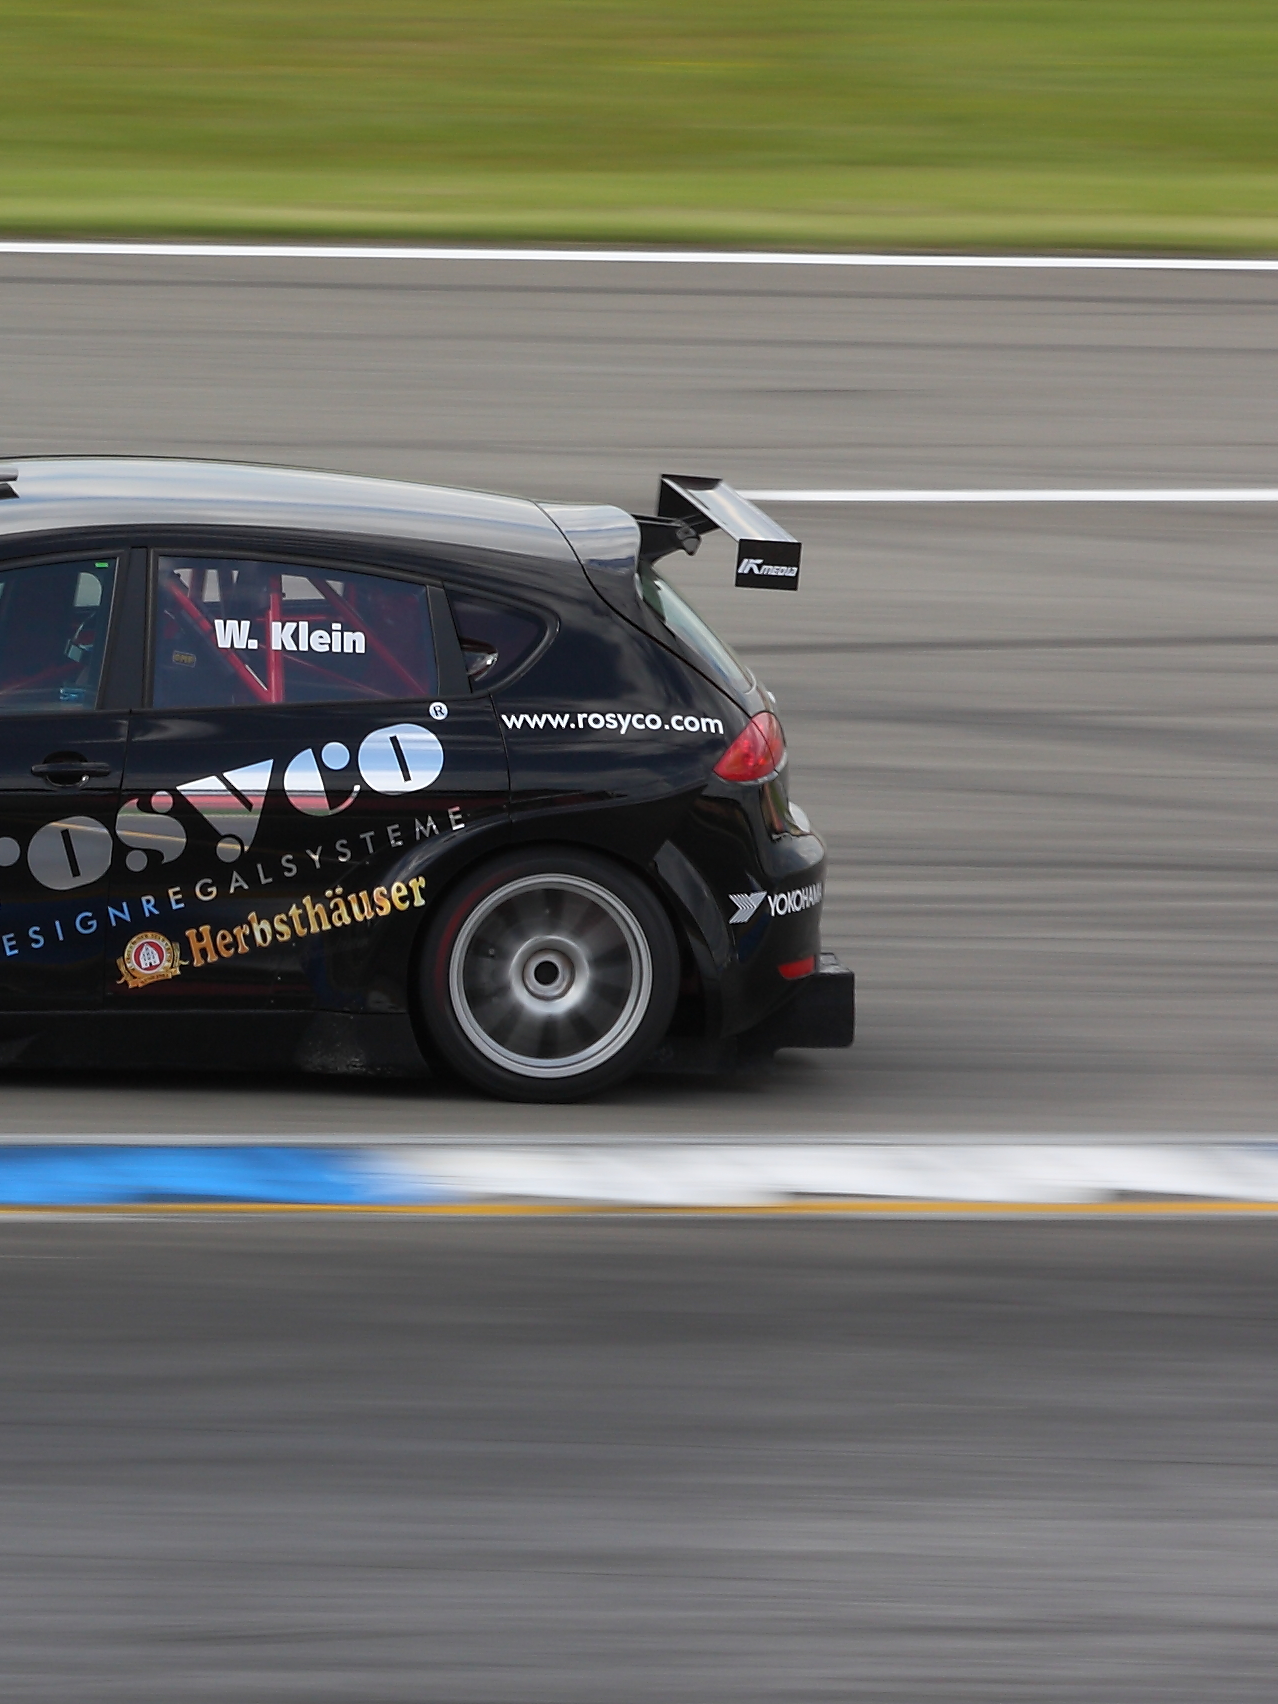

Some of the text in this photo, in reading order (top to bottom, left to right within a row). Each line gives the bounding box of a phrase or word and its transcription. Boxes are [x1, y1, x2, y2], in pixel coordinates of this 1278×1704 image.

[214, 618, 367, 654] W. Klein
[501, 712, 724, 735] www.rosyco.com
[767, 882, 822, 917] YOKOHAM
[185, 875, 427, 968] Herbsthäuser
